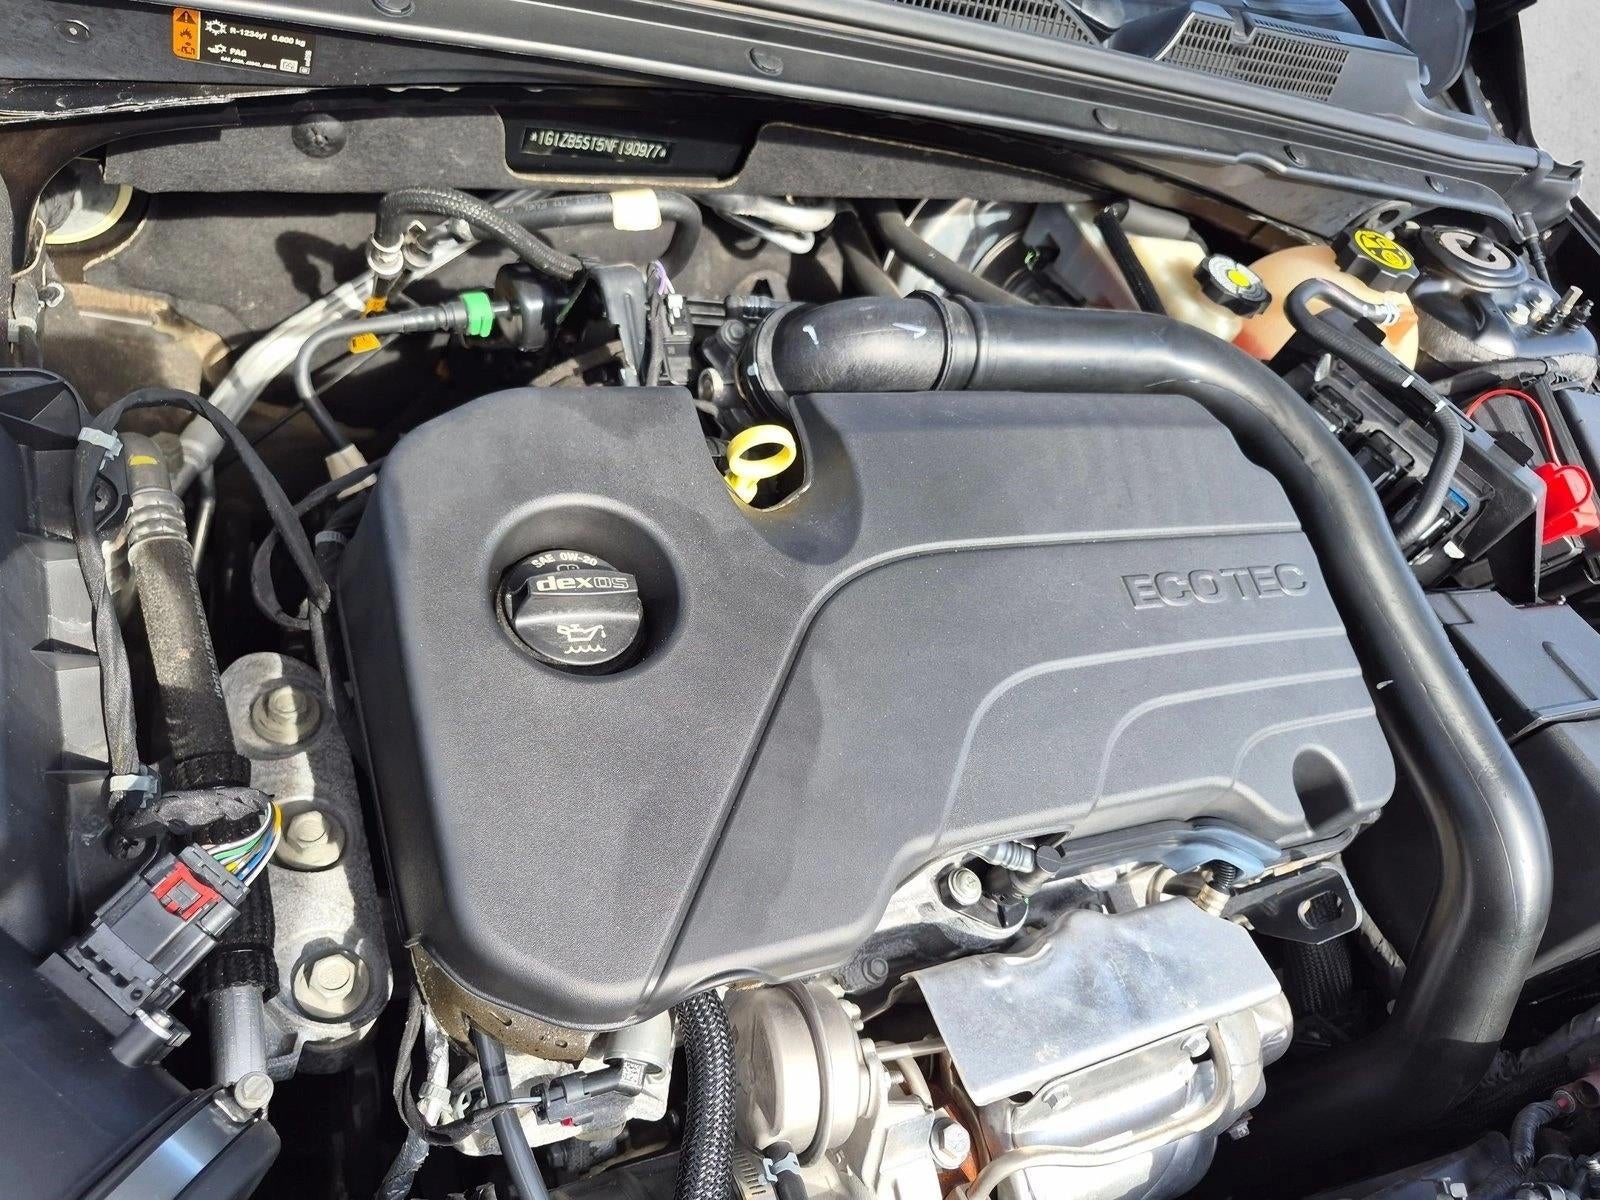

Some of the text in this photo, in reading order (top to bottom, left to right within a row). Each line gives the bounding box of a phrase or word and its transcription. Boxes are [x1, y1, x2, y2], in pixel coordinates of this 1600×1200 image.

[531, 552, 598, 569] SAE 0W-20
[536, 575, 629, 592] dexos
[1120, 563, 1310, 610] ECOTEC
